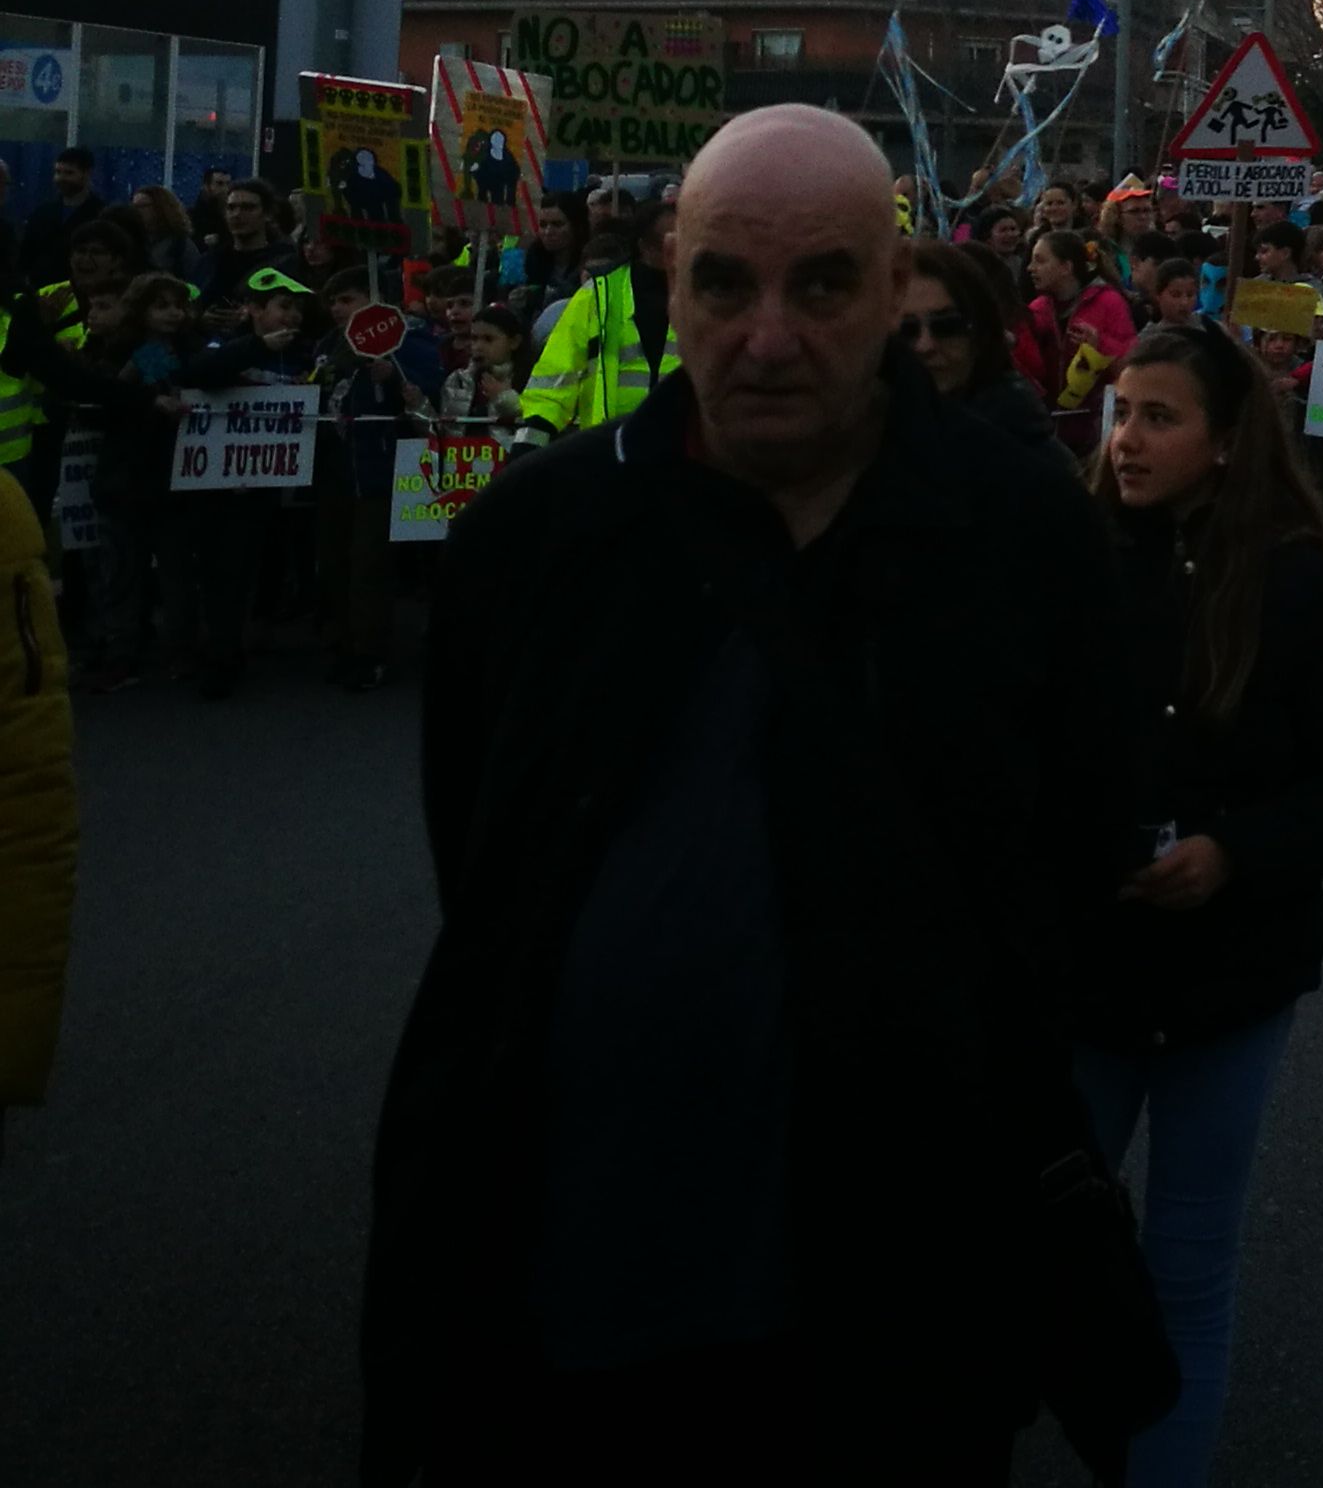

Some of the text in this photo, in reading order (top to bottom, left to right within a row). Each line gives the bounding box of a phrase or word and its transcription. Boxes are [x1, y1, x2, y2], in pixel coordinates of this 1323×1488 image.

[518, 15, 579, 63] NO
[355, 315, 398, 345] STOP
[181, 443, 300, 477] NO FUTURE
[401, 501, 466, 520] ABOC
